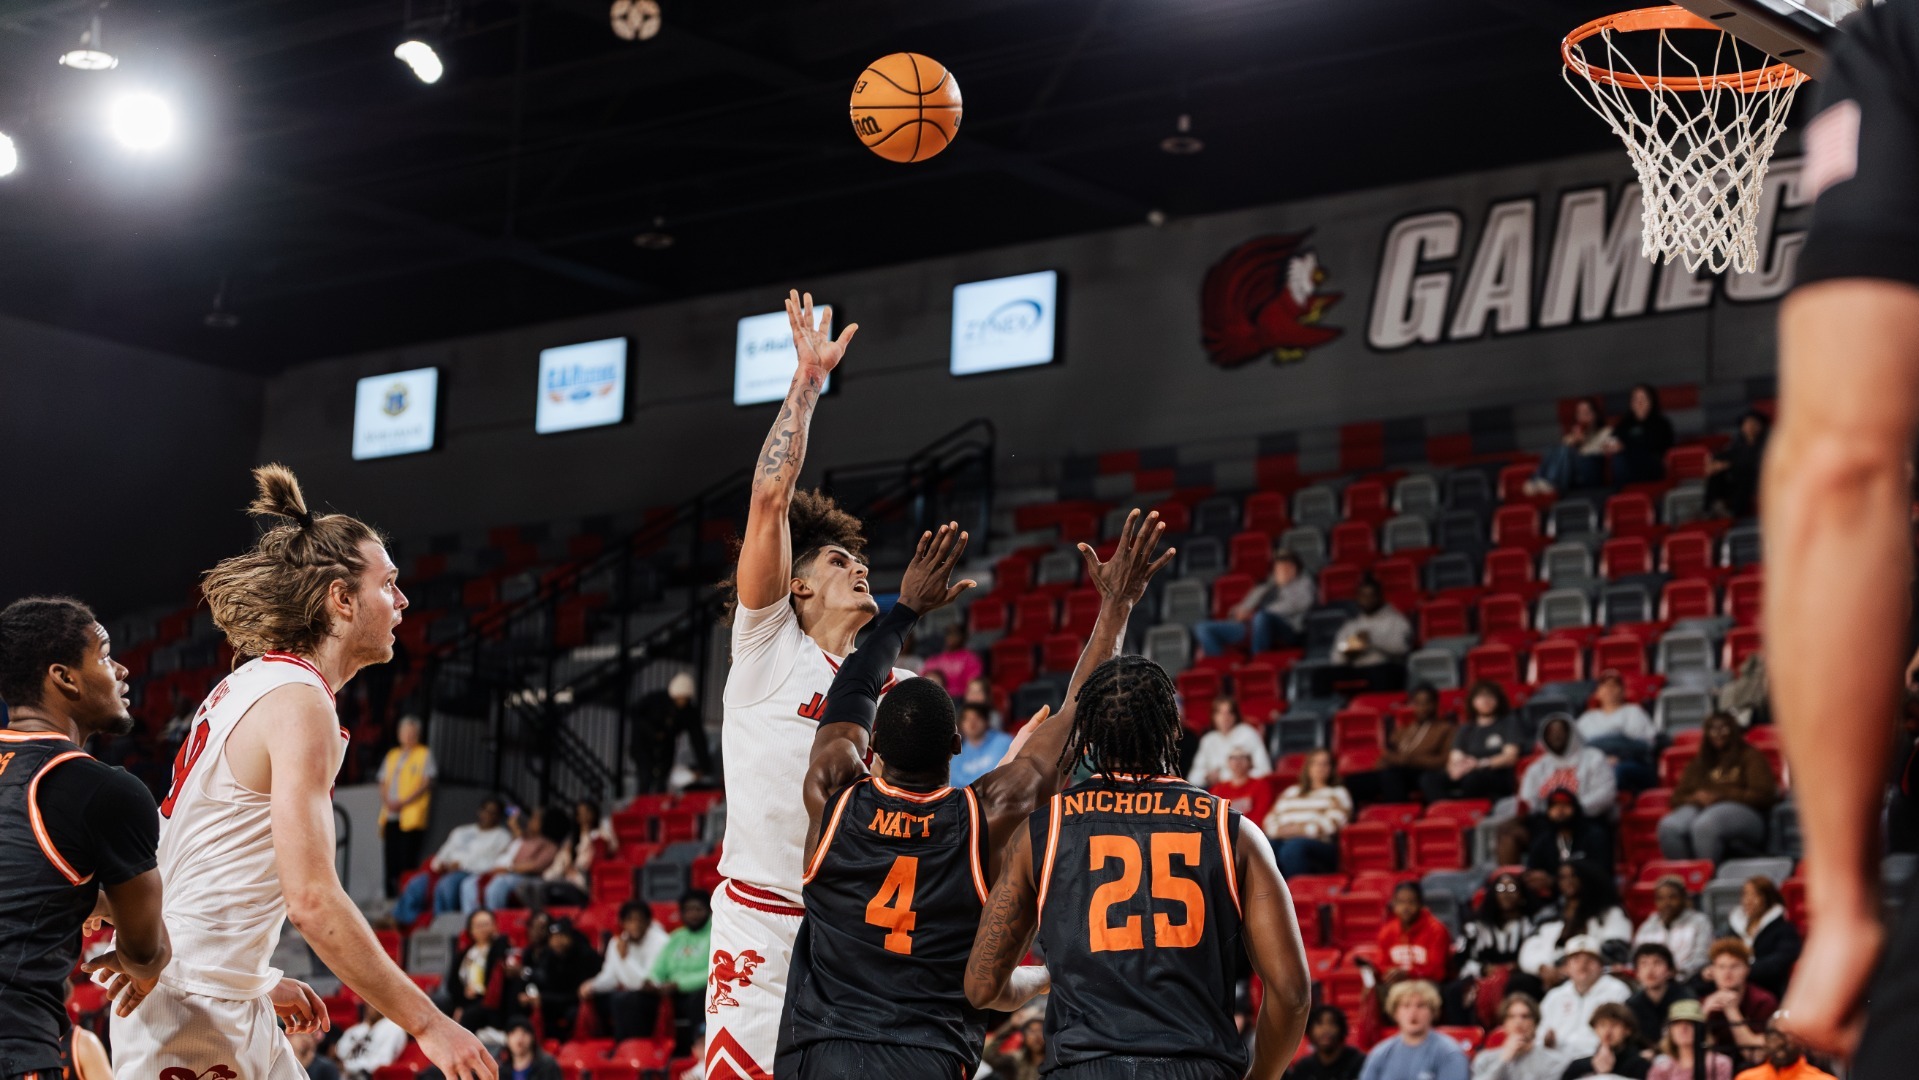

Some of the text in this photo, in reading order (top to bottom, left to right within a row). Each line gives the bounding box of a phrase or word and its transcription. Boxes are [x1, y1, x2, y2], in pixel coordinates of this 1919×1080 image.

[868, 808, 935, 838] NATT
[1064, 791, 1212, 819] NICHOLAS
[865, 856, 918, 955] 4
[1088, 832, 1206, 952] 25
